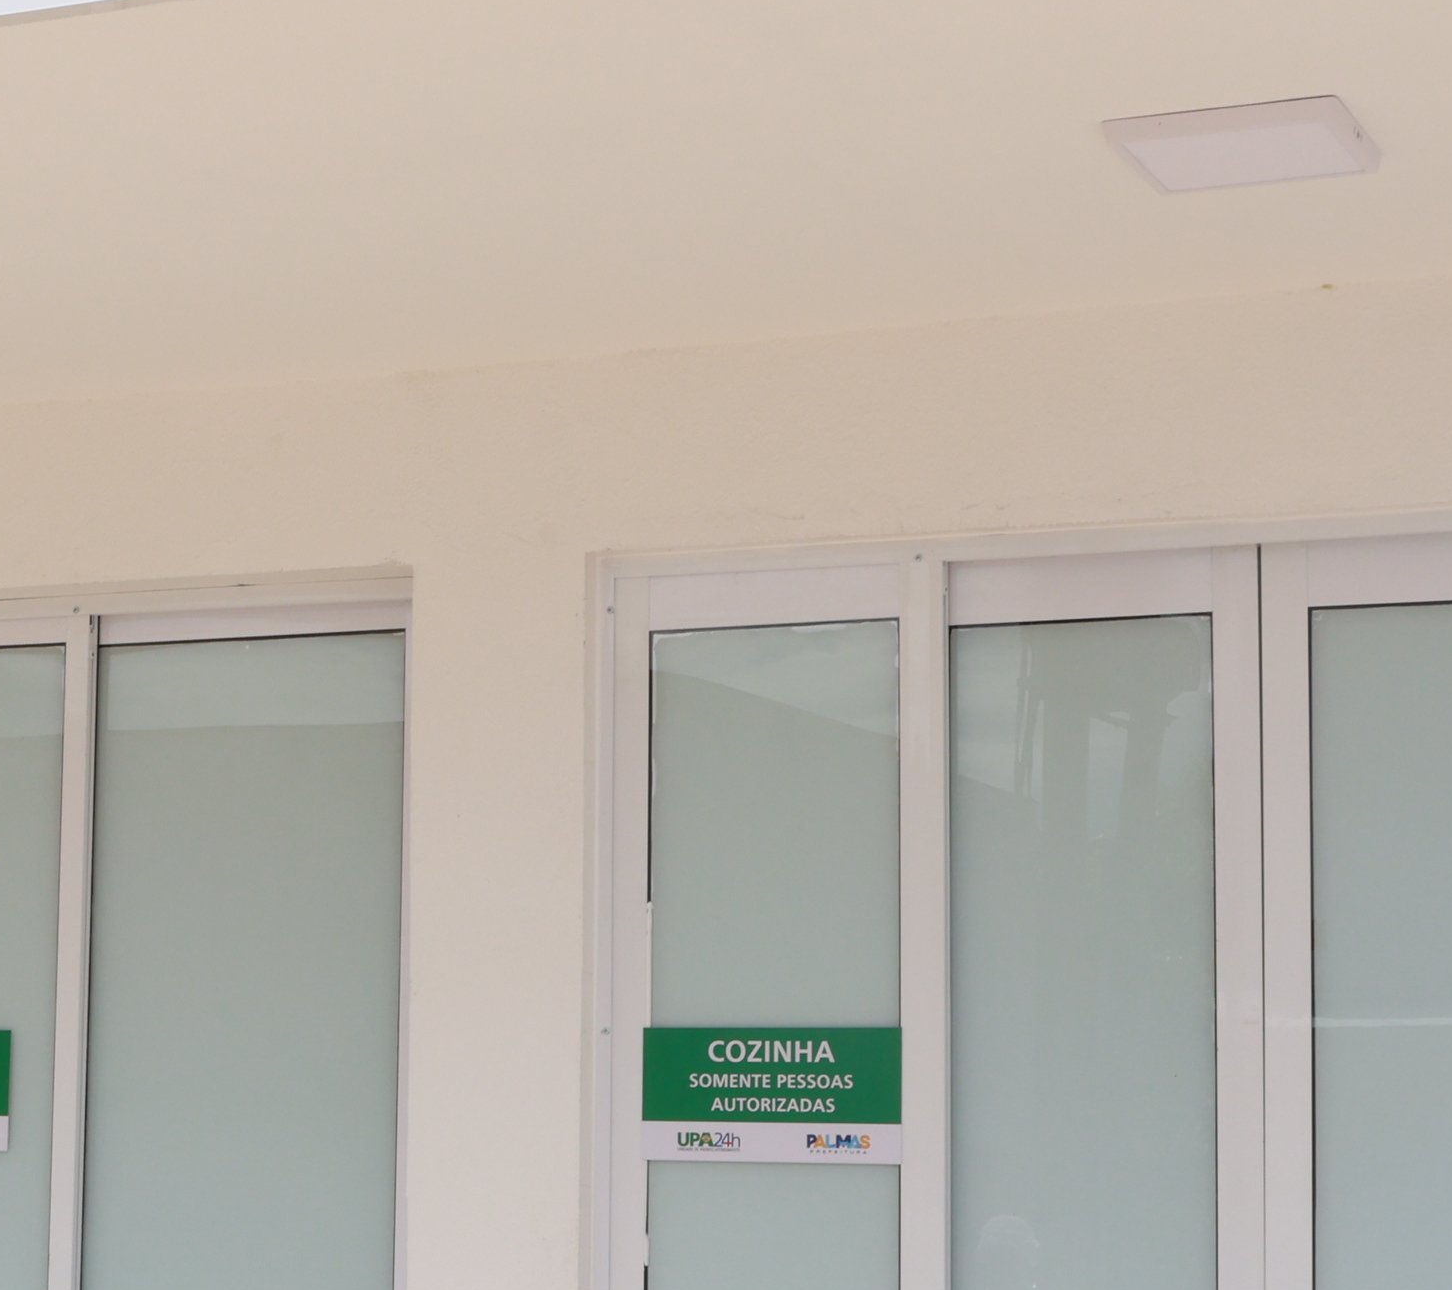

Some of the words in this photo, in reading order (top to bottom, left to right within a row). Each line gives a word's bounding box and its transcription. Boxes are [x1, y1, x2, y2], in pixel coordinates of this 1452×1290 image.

[708, 1040, 835, 1063] COZINHA
[689, 1073, 771, 1089] SOMENTE
[777, 1074, 854, 1089] PESSOAS
[711, 1097, 835, 1113] AUTORIZADAS
[807, 1134, 870, 1149] PALMAS
